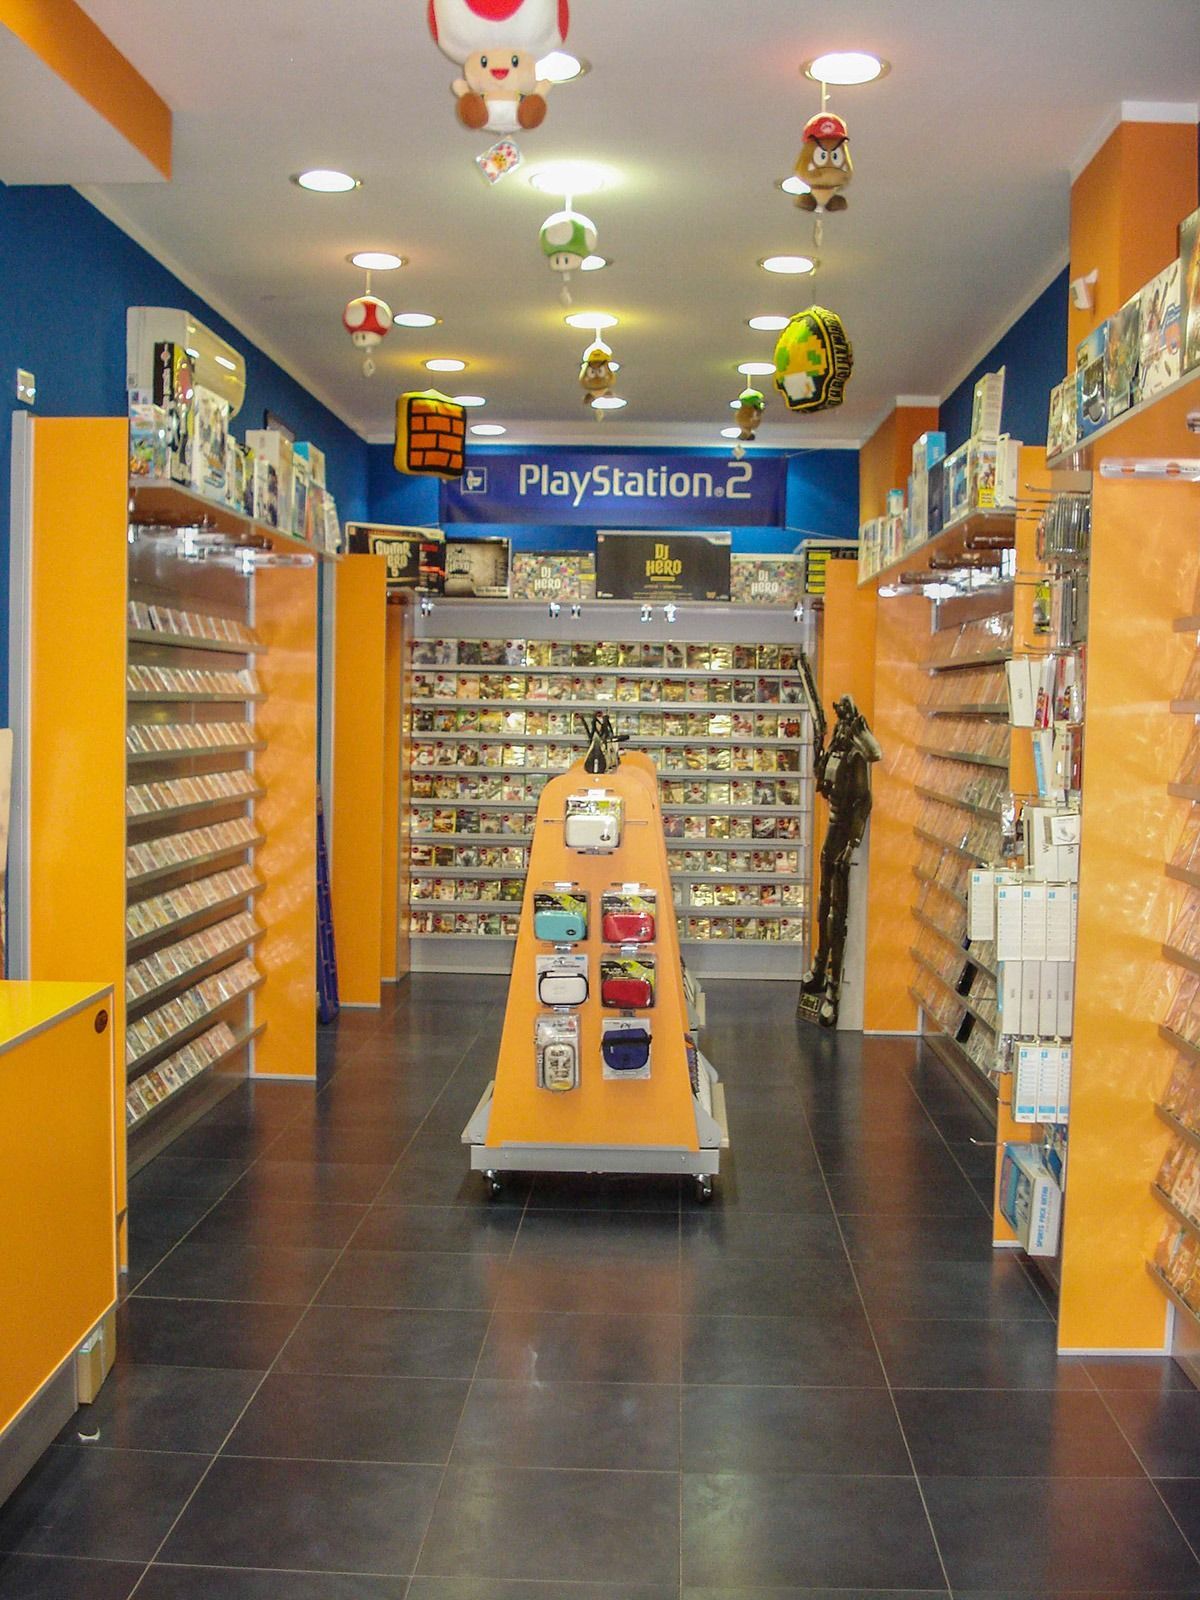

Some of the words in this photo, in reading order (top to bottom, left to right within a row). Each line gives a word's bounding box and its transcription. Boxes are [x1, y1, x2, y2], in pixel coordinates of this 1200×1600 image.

[654, 543, 670, 560] DJ
[387, 555, 408, 570] ERO
[541, 566, 551, 578] DJ
